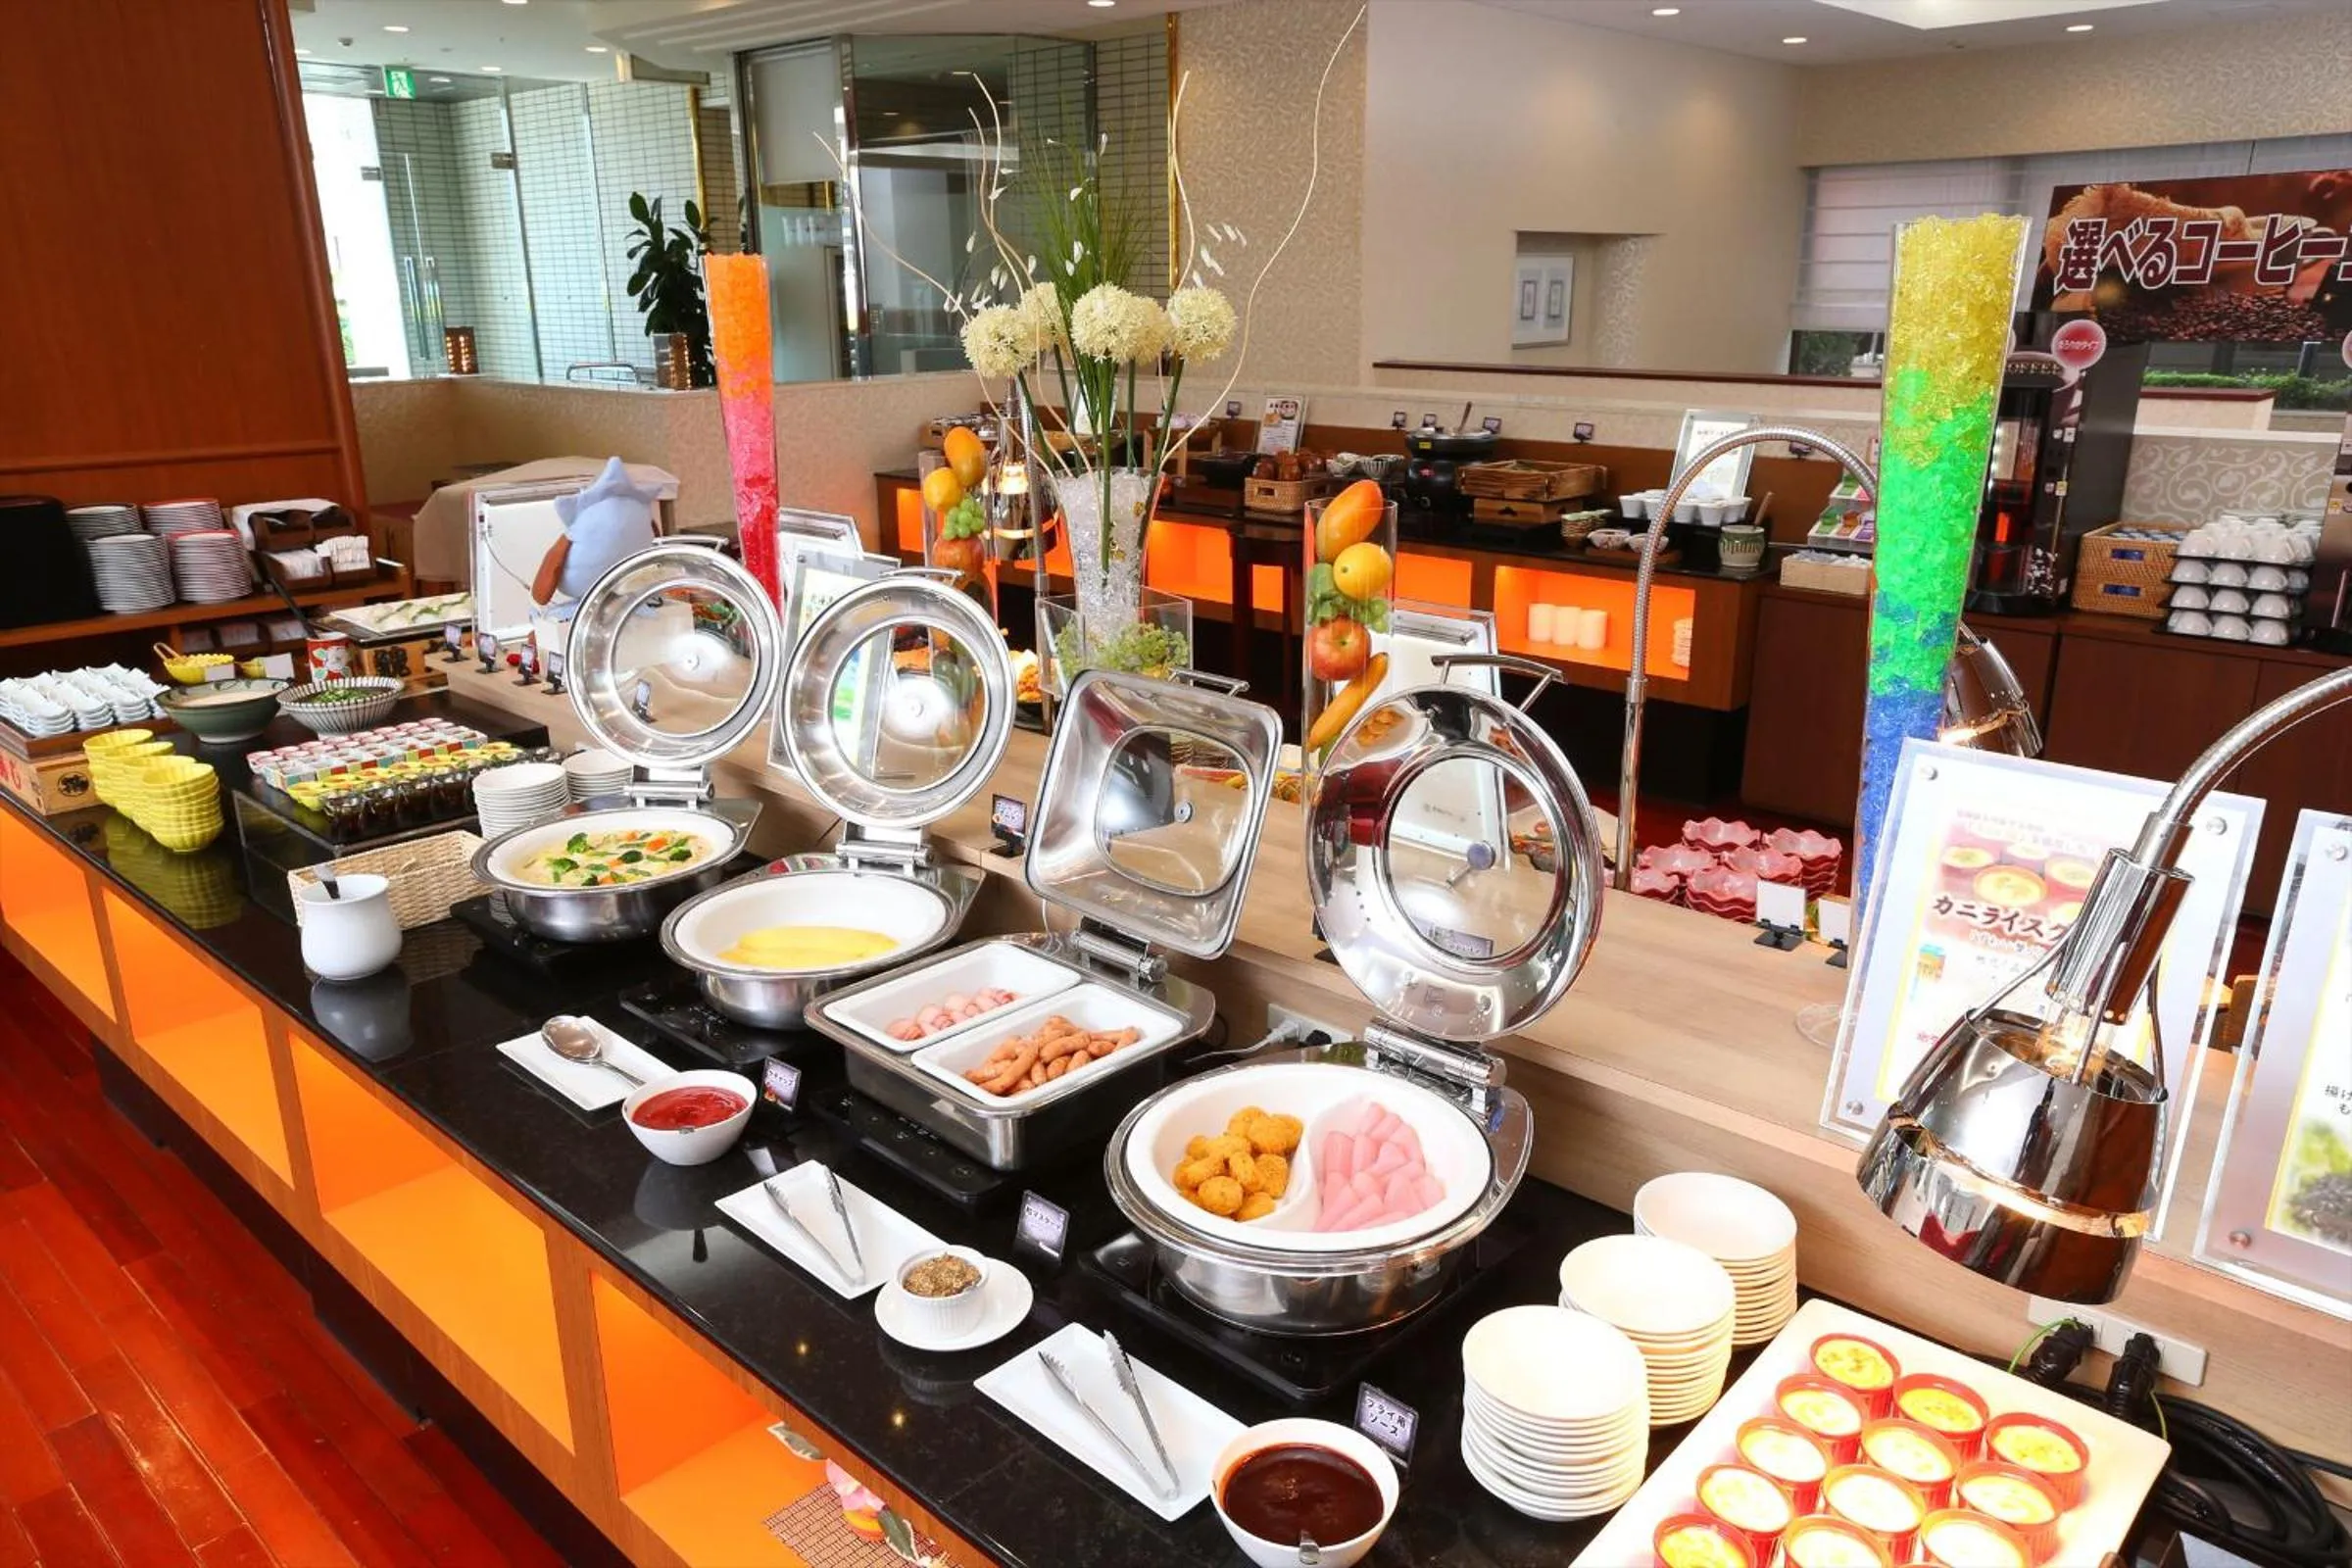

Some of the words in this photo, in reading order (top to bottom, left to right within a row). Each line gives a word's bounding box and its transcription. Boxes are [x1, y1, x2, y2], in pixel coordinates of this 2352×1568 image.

[2054, 213, 2352, 295] 選べるコーヒー
[2006, 363, 2061, 375] OFFEE
[1370, 1412, 1399, 1438] ソース
